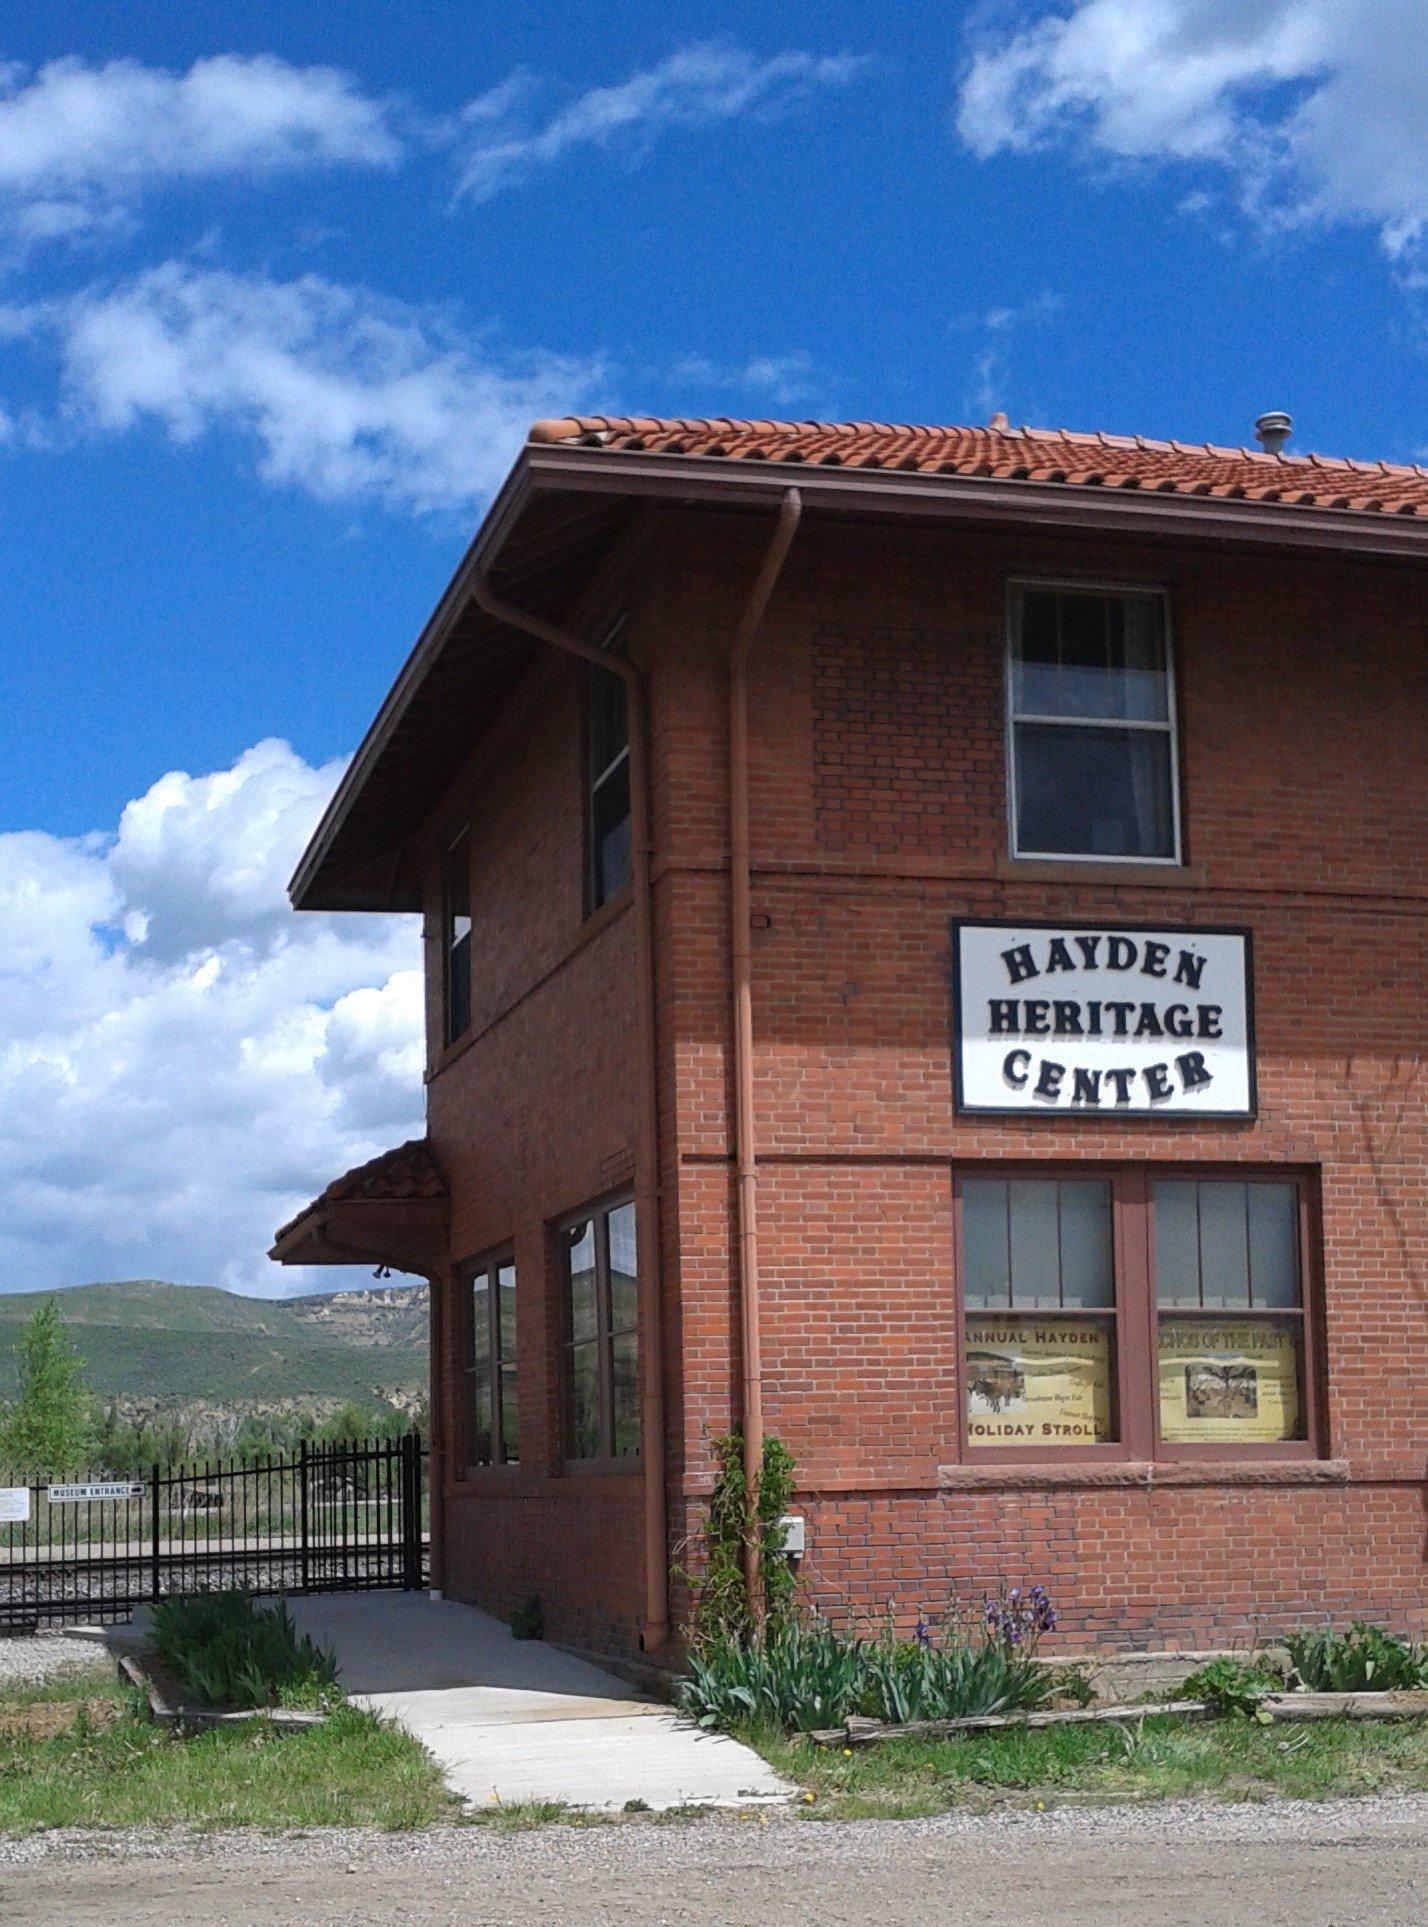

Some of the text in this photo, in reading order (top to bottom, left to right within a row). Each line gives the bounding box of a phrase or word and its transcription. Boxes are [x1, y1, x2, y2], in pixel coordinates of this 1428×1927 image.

[1001, 936, 1207, 989] HAYDEN
[988, 999, 1223, 1038] HERITAGE
[1003, 1049, 1213, 1105] CENTER
[1036, 1330, 1099, 1343] HAYDEN
[1042, 1423, 1101, 1435] STROLL
[53, 1487, 130, 1497] MUSEUM ENTRANCE
